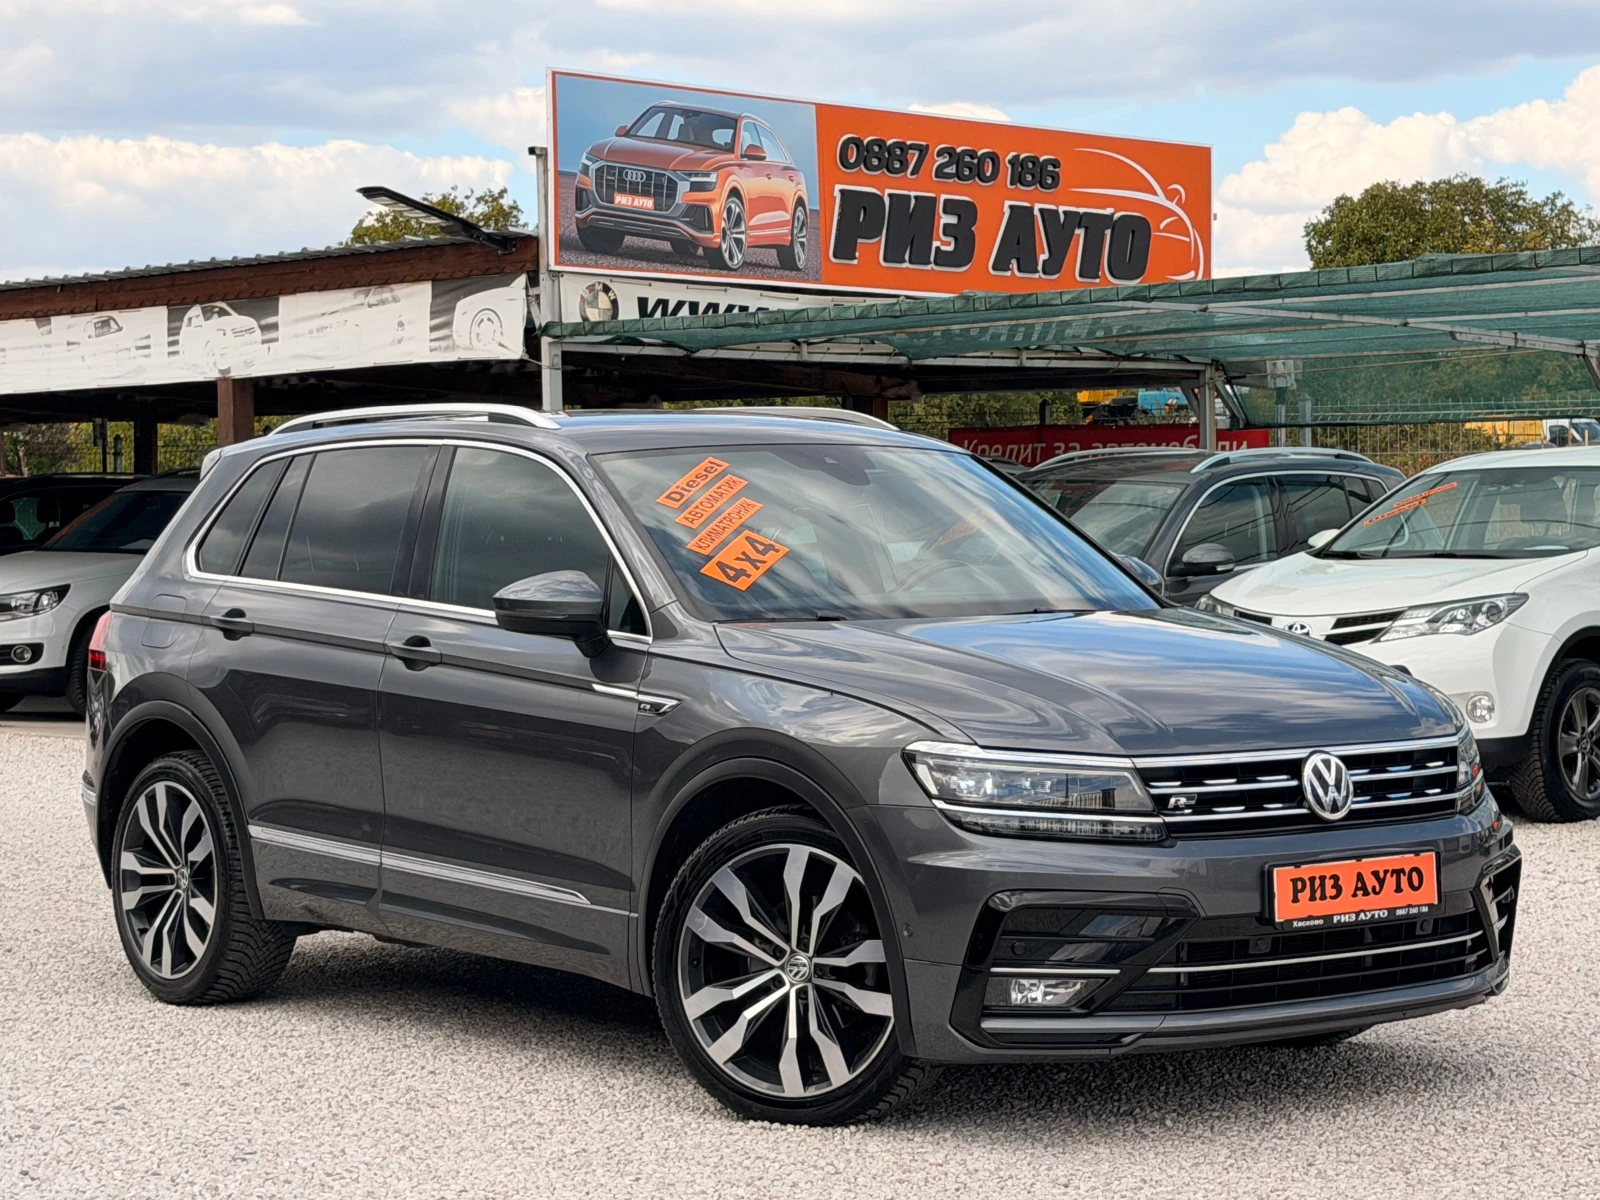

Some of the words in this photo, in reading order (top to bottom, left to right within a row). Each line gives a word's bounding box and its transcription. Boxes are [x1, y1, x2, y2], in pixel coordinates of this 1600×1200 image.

[837, 134, 930, 179] 0887
[933, 144, 1000, 186] 260
[1007, 152, 1061, 193] 186
[830, 184, 978, 272] РИЗ
[989, 201, 1151, 284] АУТО
[665, 460, 723, 503] Diesel
[683, 477, 743, 525] АВТОМАТИК
[1290, 874, 1342, 903] РИЗ
[1351, 867, 1424, 898] АУТО
[1333, 913, 1355, 924] РИЗ
[1358, 910, 1388, 921] АУТО
